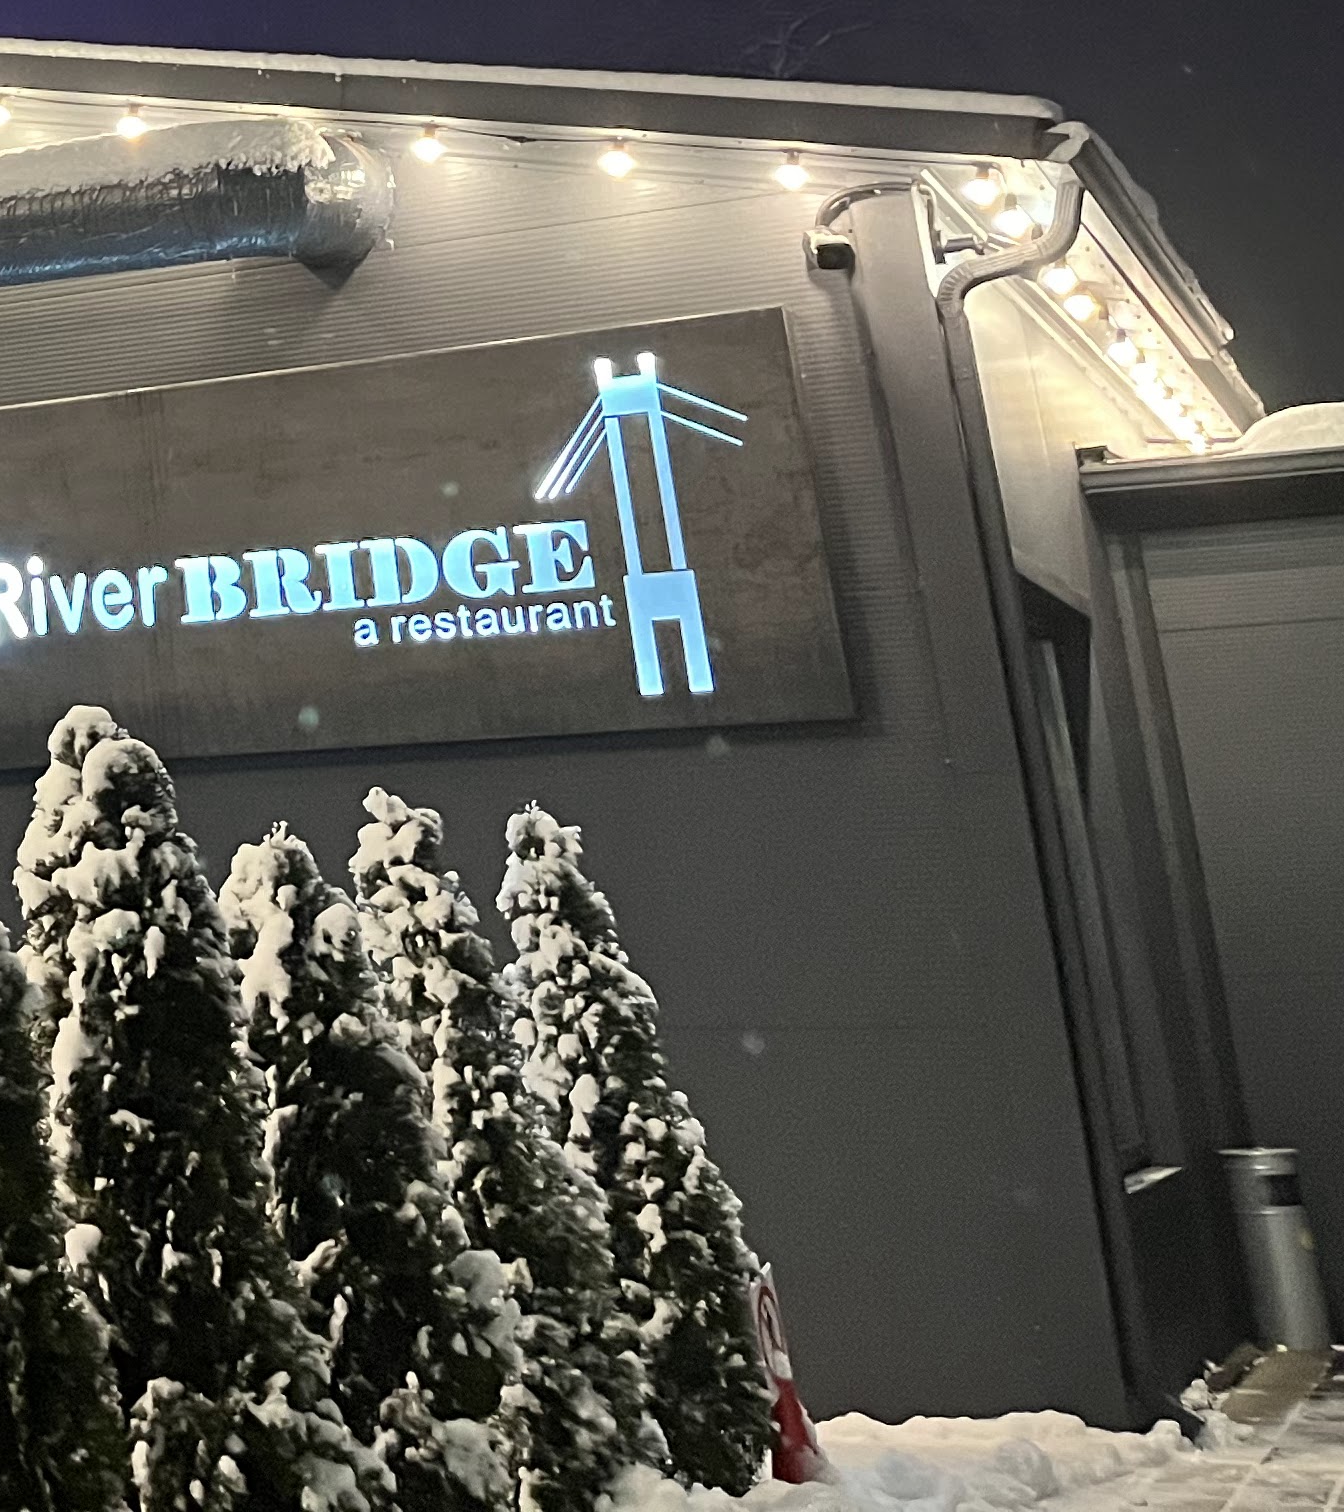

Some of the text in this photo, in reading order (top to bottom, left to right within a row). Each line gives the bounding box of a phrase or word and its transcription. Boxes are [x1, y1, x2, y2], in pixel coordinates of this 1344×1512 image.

[175, 520, 596, 623] BRIDGE
[353, 594, 617, 647] a restaurant
